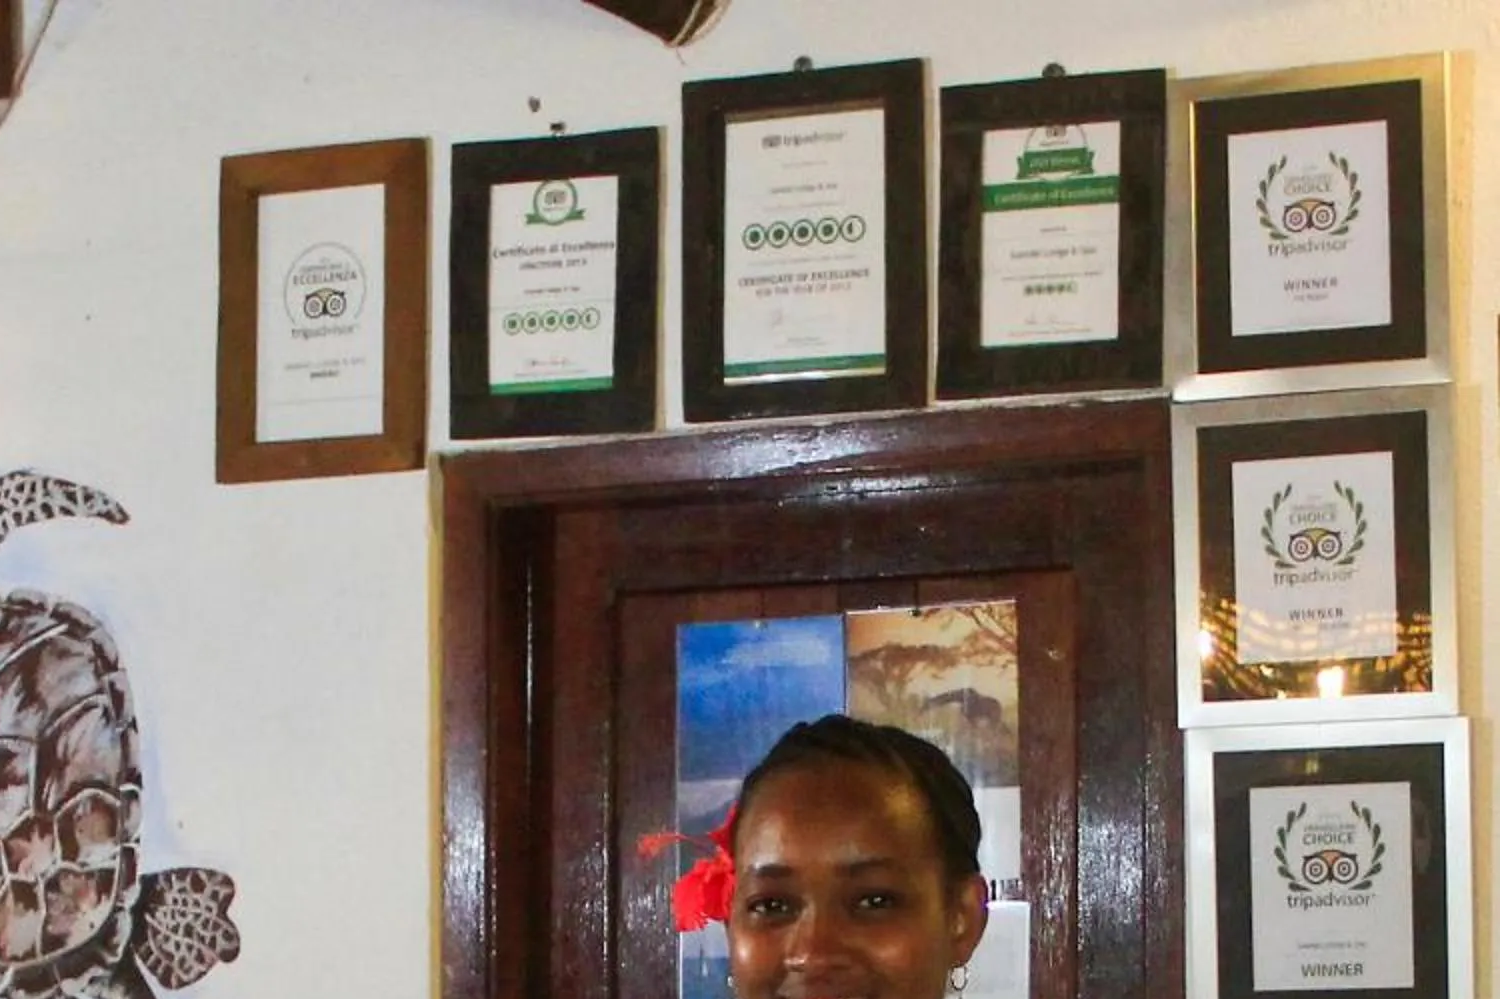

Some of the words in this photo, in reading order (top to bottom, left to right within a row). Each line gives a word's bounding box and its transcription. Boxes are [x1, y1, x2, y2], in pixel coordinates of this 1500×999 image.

[1268, 238, 1349, 257] tripadvisor
[1284, 276, 1339, 292] WINNER
[1273, 568, 1353, 588] tripadvisor
[1288, 607, 1344, 623] WINNER
[1303, 831, 1355, 847] CHOICE
[1286, 891, 1371, 912] tripadvisor
[1301, 963, 1364, 978] WINNER
